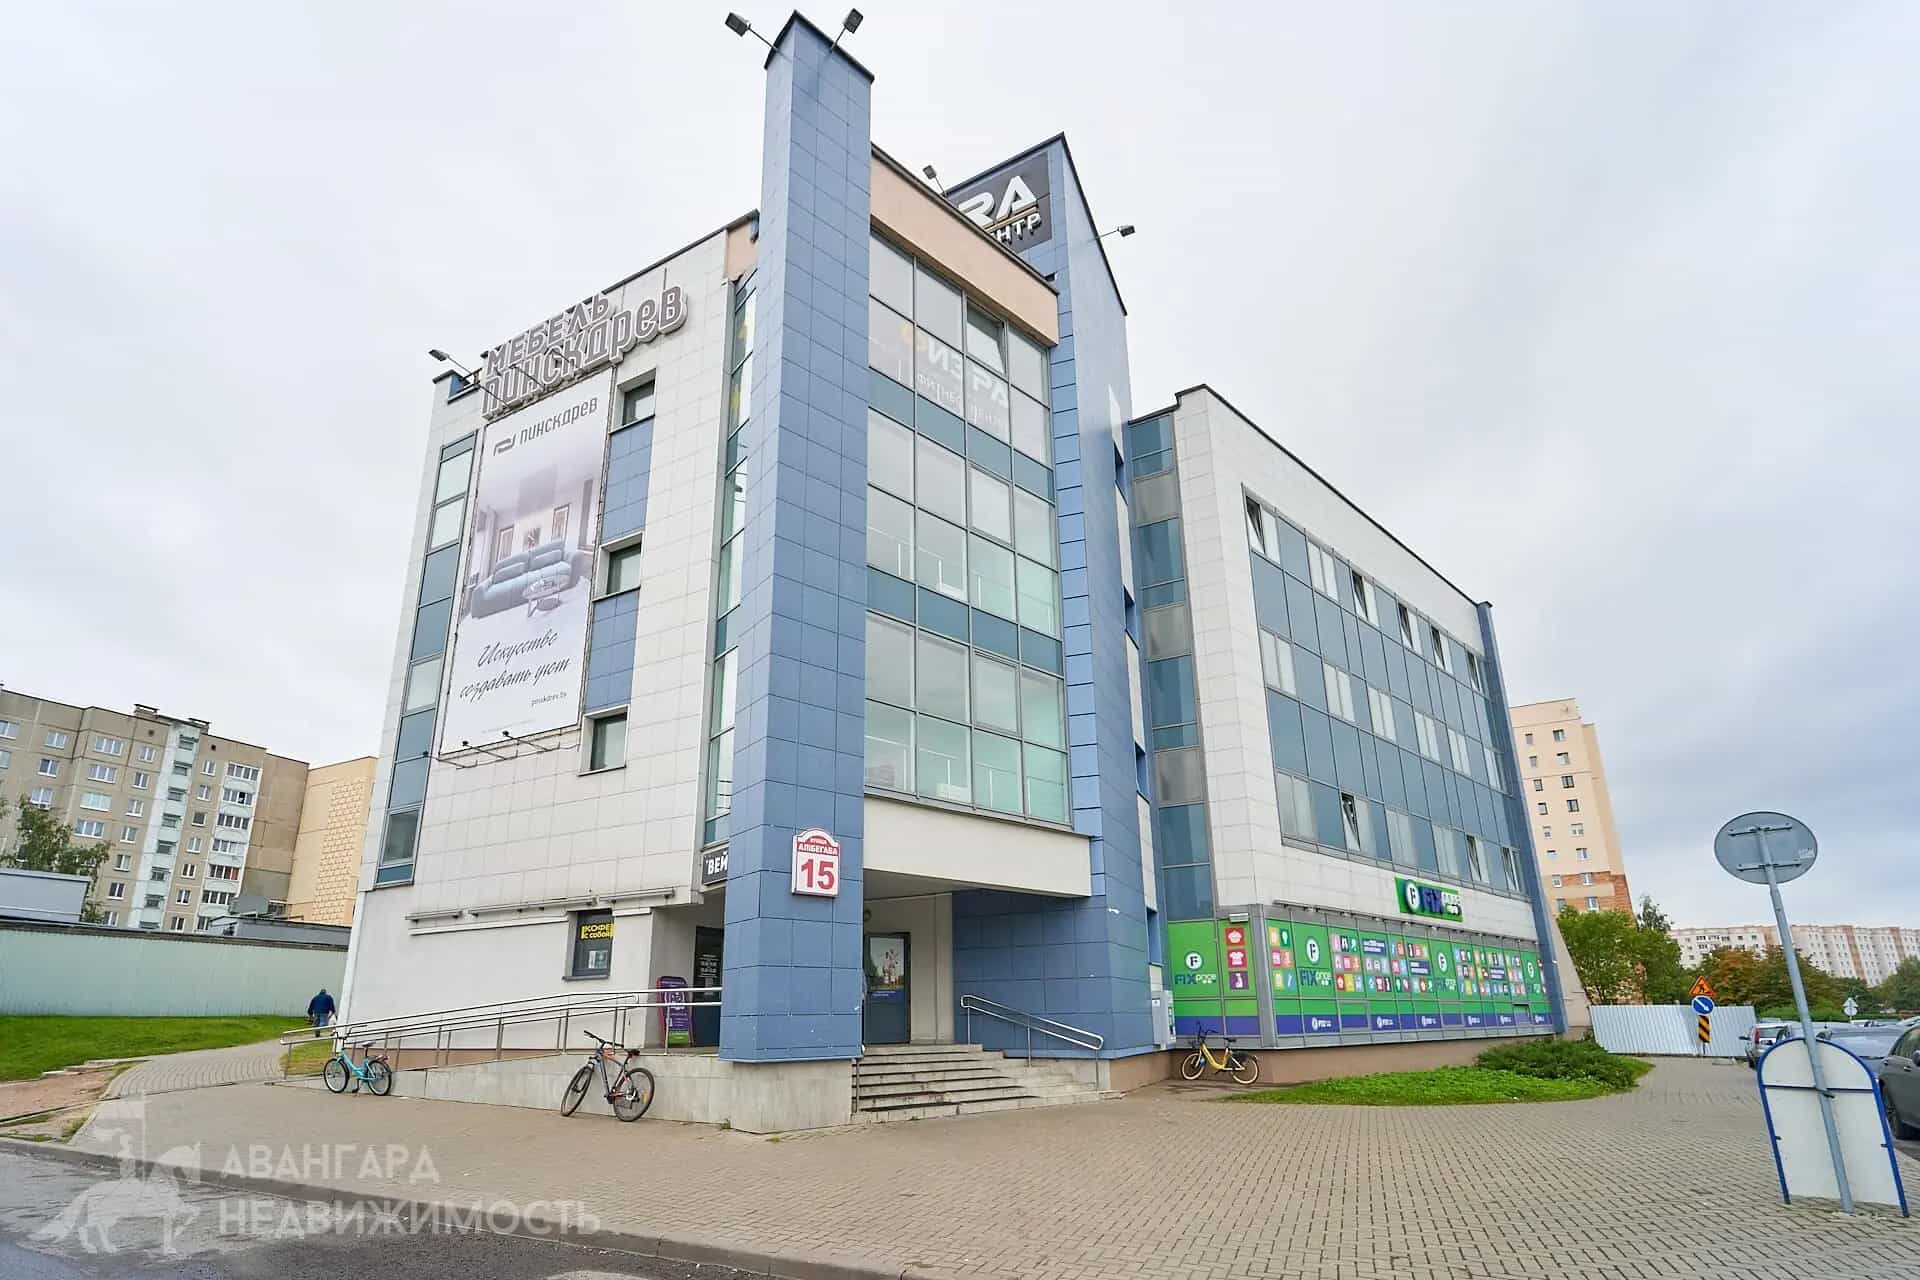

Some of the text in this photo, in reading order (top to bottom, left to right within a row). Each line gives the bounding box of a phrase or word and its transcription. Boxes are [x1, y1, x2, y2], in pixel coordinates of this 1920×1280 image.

[486, 294, 611, 376] МЕБЕЛЬ
[478, 628, 558, 667] Искусство
[460, 658, 570, 702] создавать уют
[801, 859, 835, 890] 15
